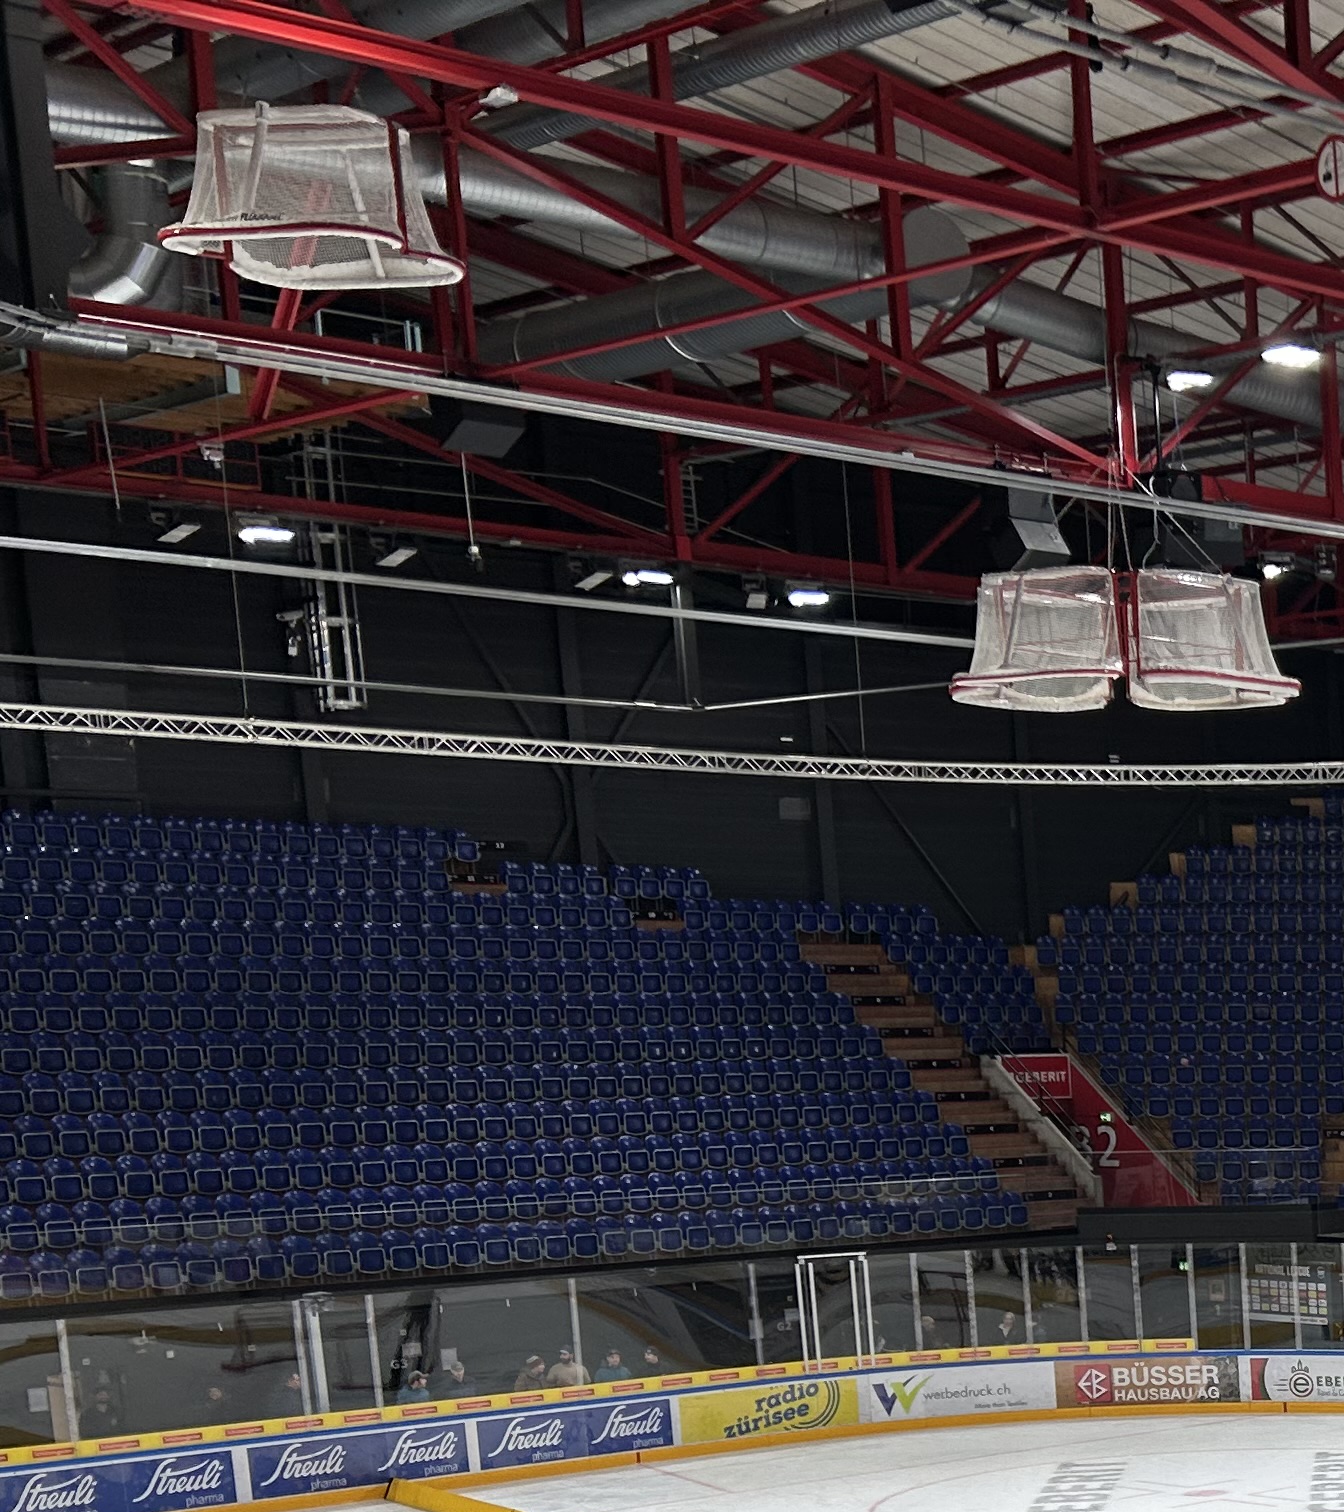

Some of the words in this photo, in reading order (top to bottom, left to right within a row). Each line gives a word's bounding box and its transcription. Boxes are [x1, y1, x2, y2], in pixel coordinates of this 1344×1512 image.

[1014, 1069, 1067, 1085] GEBERIT
[1112, 1362, 1220, 1387] BÜSSER
[754, 1381, 820, 1413] radio
[922, 1384, 1011, 1401] werbedruck.ch
[1114, 1386, 1193, 1401] HAUSBAU
[1197, 1386, 1220, 1400] AG
[592, 1405, 664, 1445] Streuli
[724, 1401, 810, 1439] zürisee
[488, 1417, 565, 1458] Streuli
[632, 1436, 664, 1449] pharma
[379, 1430, 457, 1472] Streuli
[531, 1449, 565, 1463] pharma
[261, 1443, 347, 1487] Streuli
[424, 1462, 458, 1478] pharma
[133, 1458, 224, 1503] Streuli
[311, 1477, 347, 1493] pharma
[185, 1491, 225, 1509] pharma
